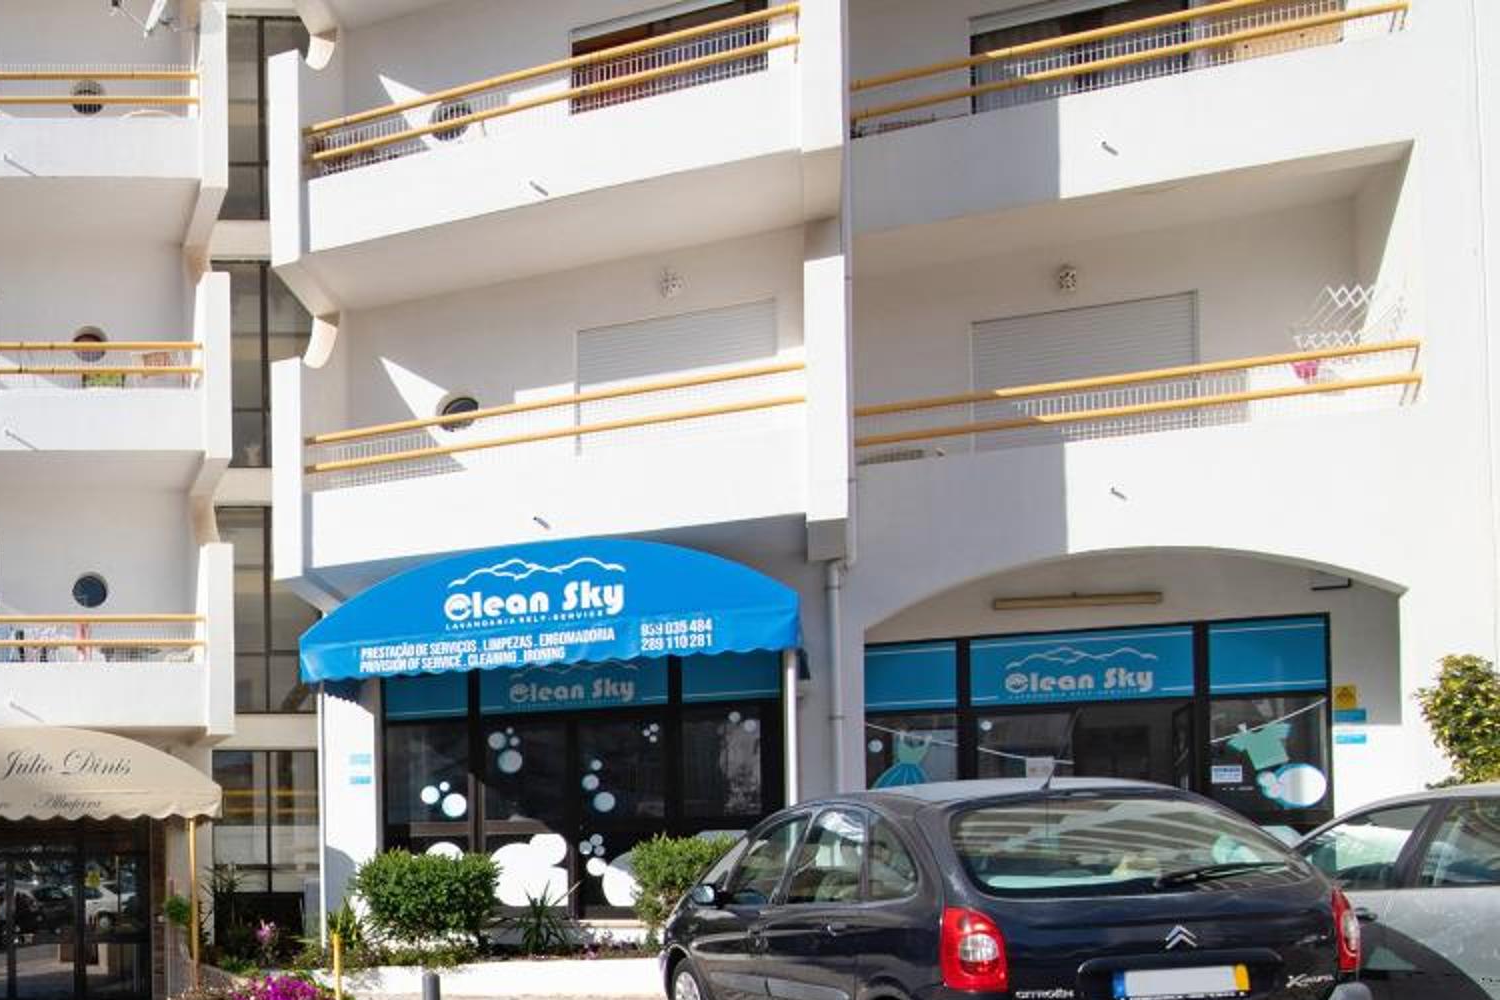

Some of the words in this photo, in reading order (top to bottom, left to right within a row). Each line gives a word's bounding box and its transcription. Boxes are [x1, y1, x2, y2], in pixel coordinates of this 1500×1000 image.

[444, 592, 549, 621] Clean
[562, 580, 625, 615] Sky
[509, 682, 584, 703] Clean
[592, 677, 635, 702] Sky
[1006, 672, 1095, 693] Clean
[1103, 667, 1154, 691] Sky
